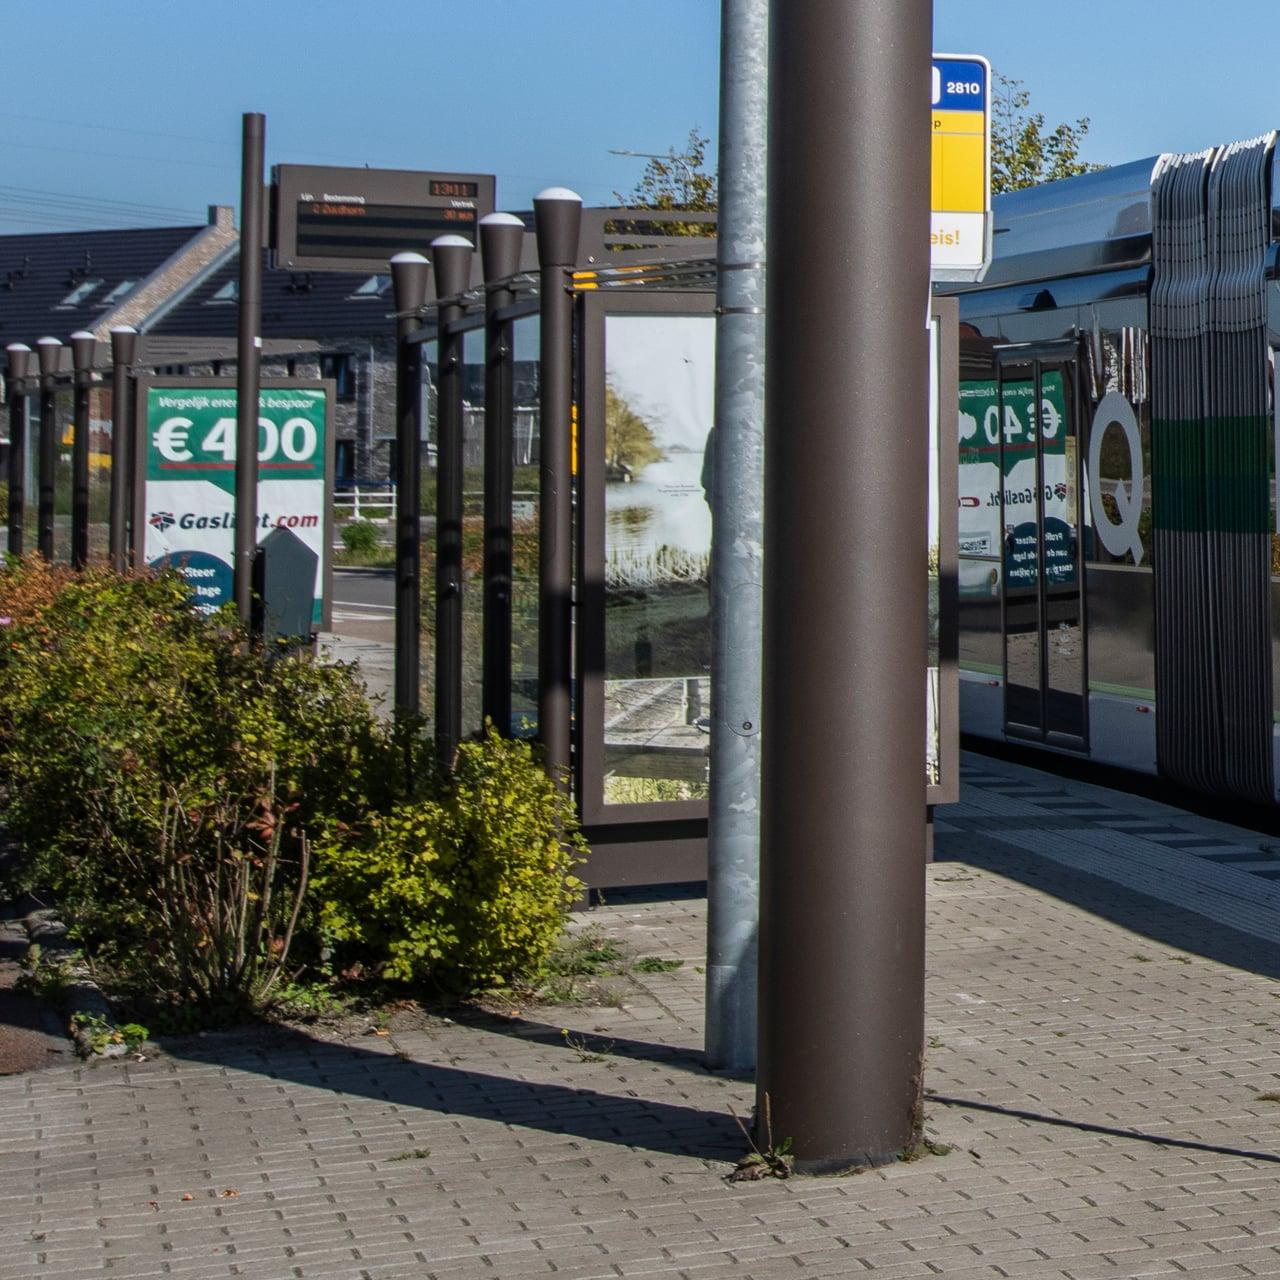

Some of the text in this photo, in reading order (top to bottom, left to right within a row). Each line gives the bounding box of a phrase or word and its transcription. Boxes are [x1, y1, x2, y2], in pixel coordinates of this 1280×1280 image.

[946, 82, 981, 95] 2810
[433, 182, 469, 196] 13:11
[1088, 391, 1145, 567] Q
[179, 512, 318, 531] Gaslit.com
